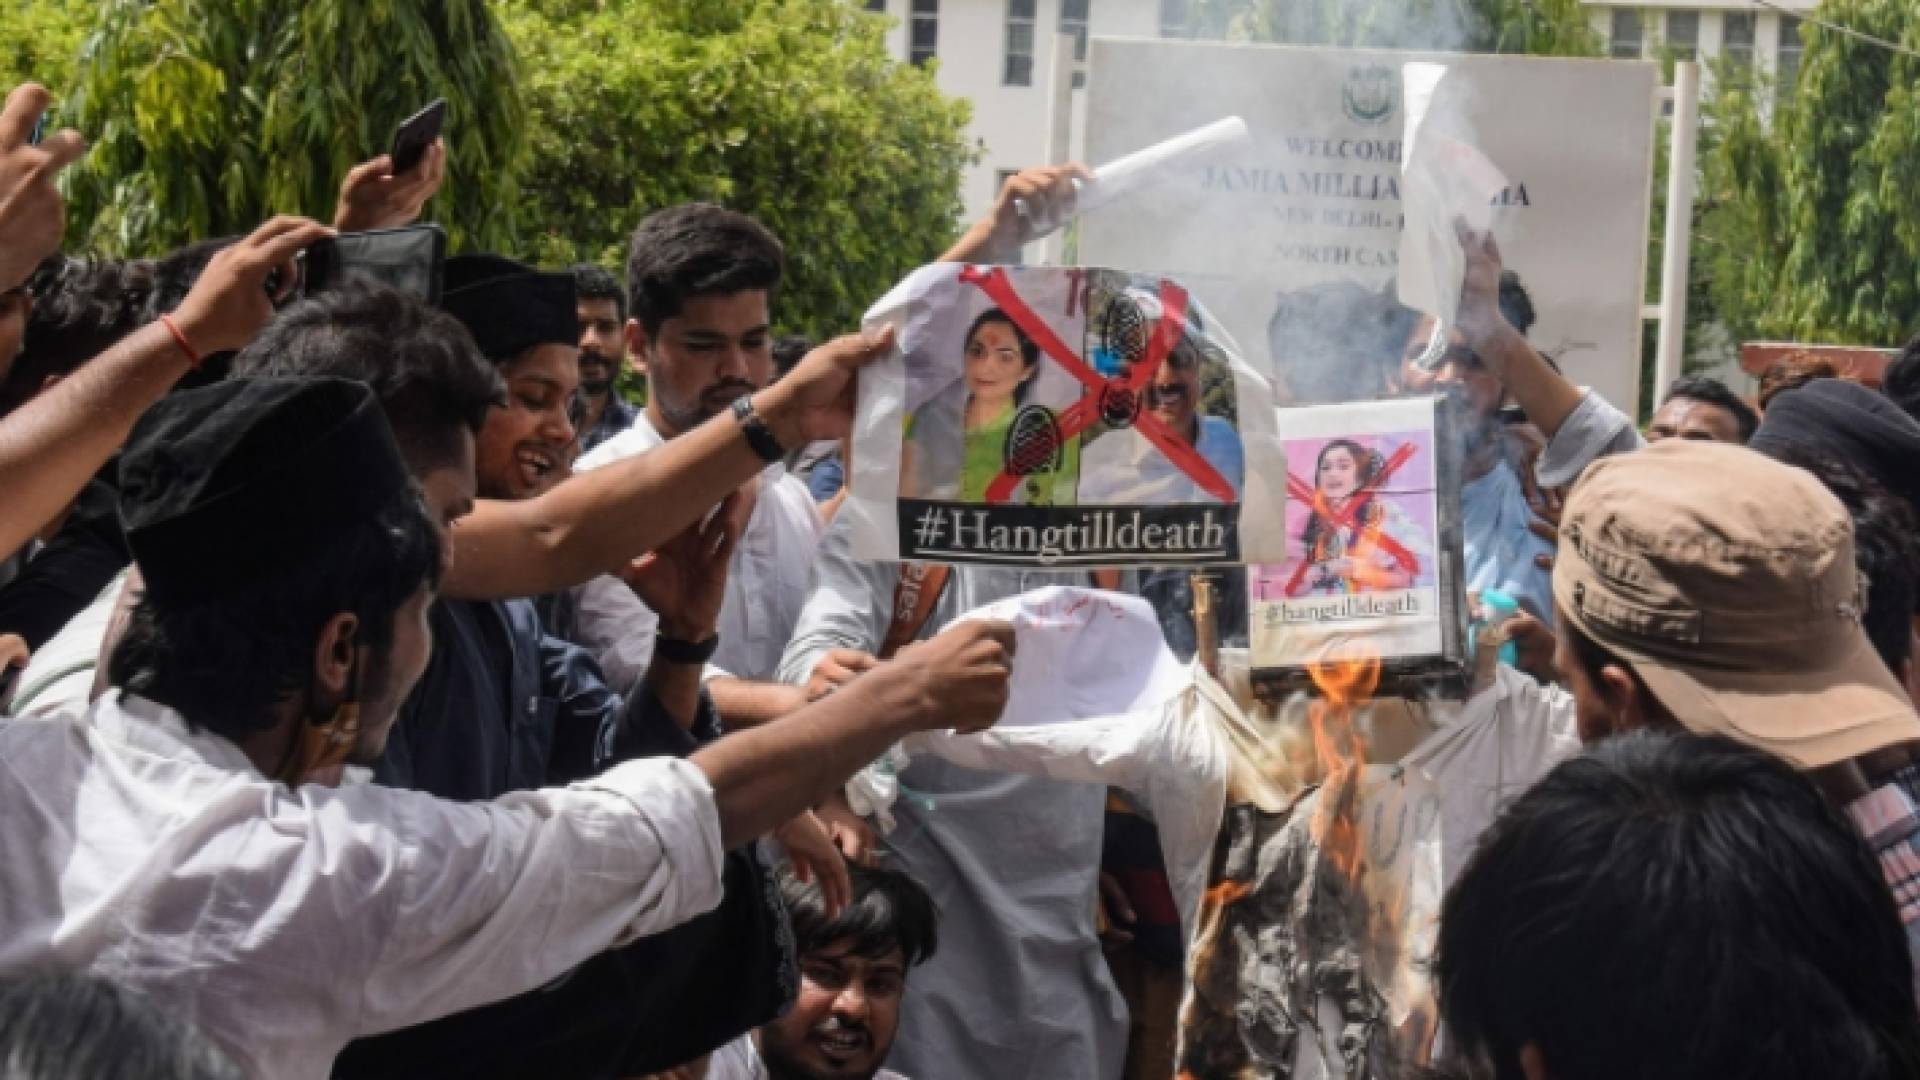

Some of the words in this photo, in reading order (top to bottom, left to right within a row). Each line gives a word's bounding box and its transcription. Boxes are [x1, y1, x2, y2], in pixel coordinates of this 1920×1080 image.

[1201, 167, 1289, 195] JAMIA
[1296, 171, 1400, 200] MILLIA
[1274, 243, 1351, 265] NORTH
[912, 504, 1225, 562] #Hangtilldeath
[1265, 591, 1419, 624] #hangtilldeath
